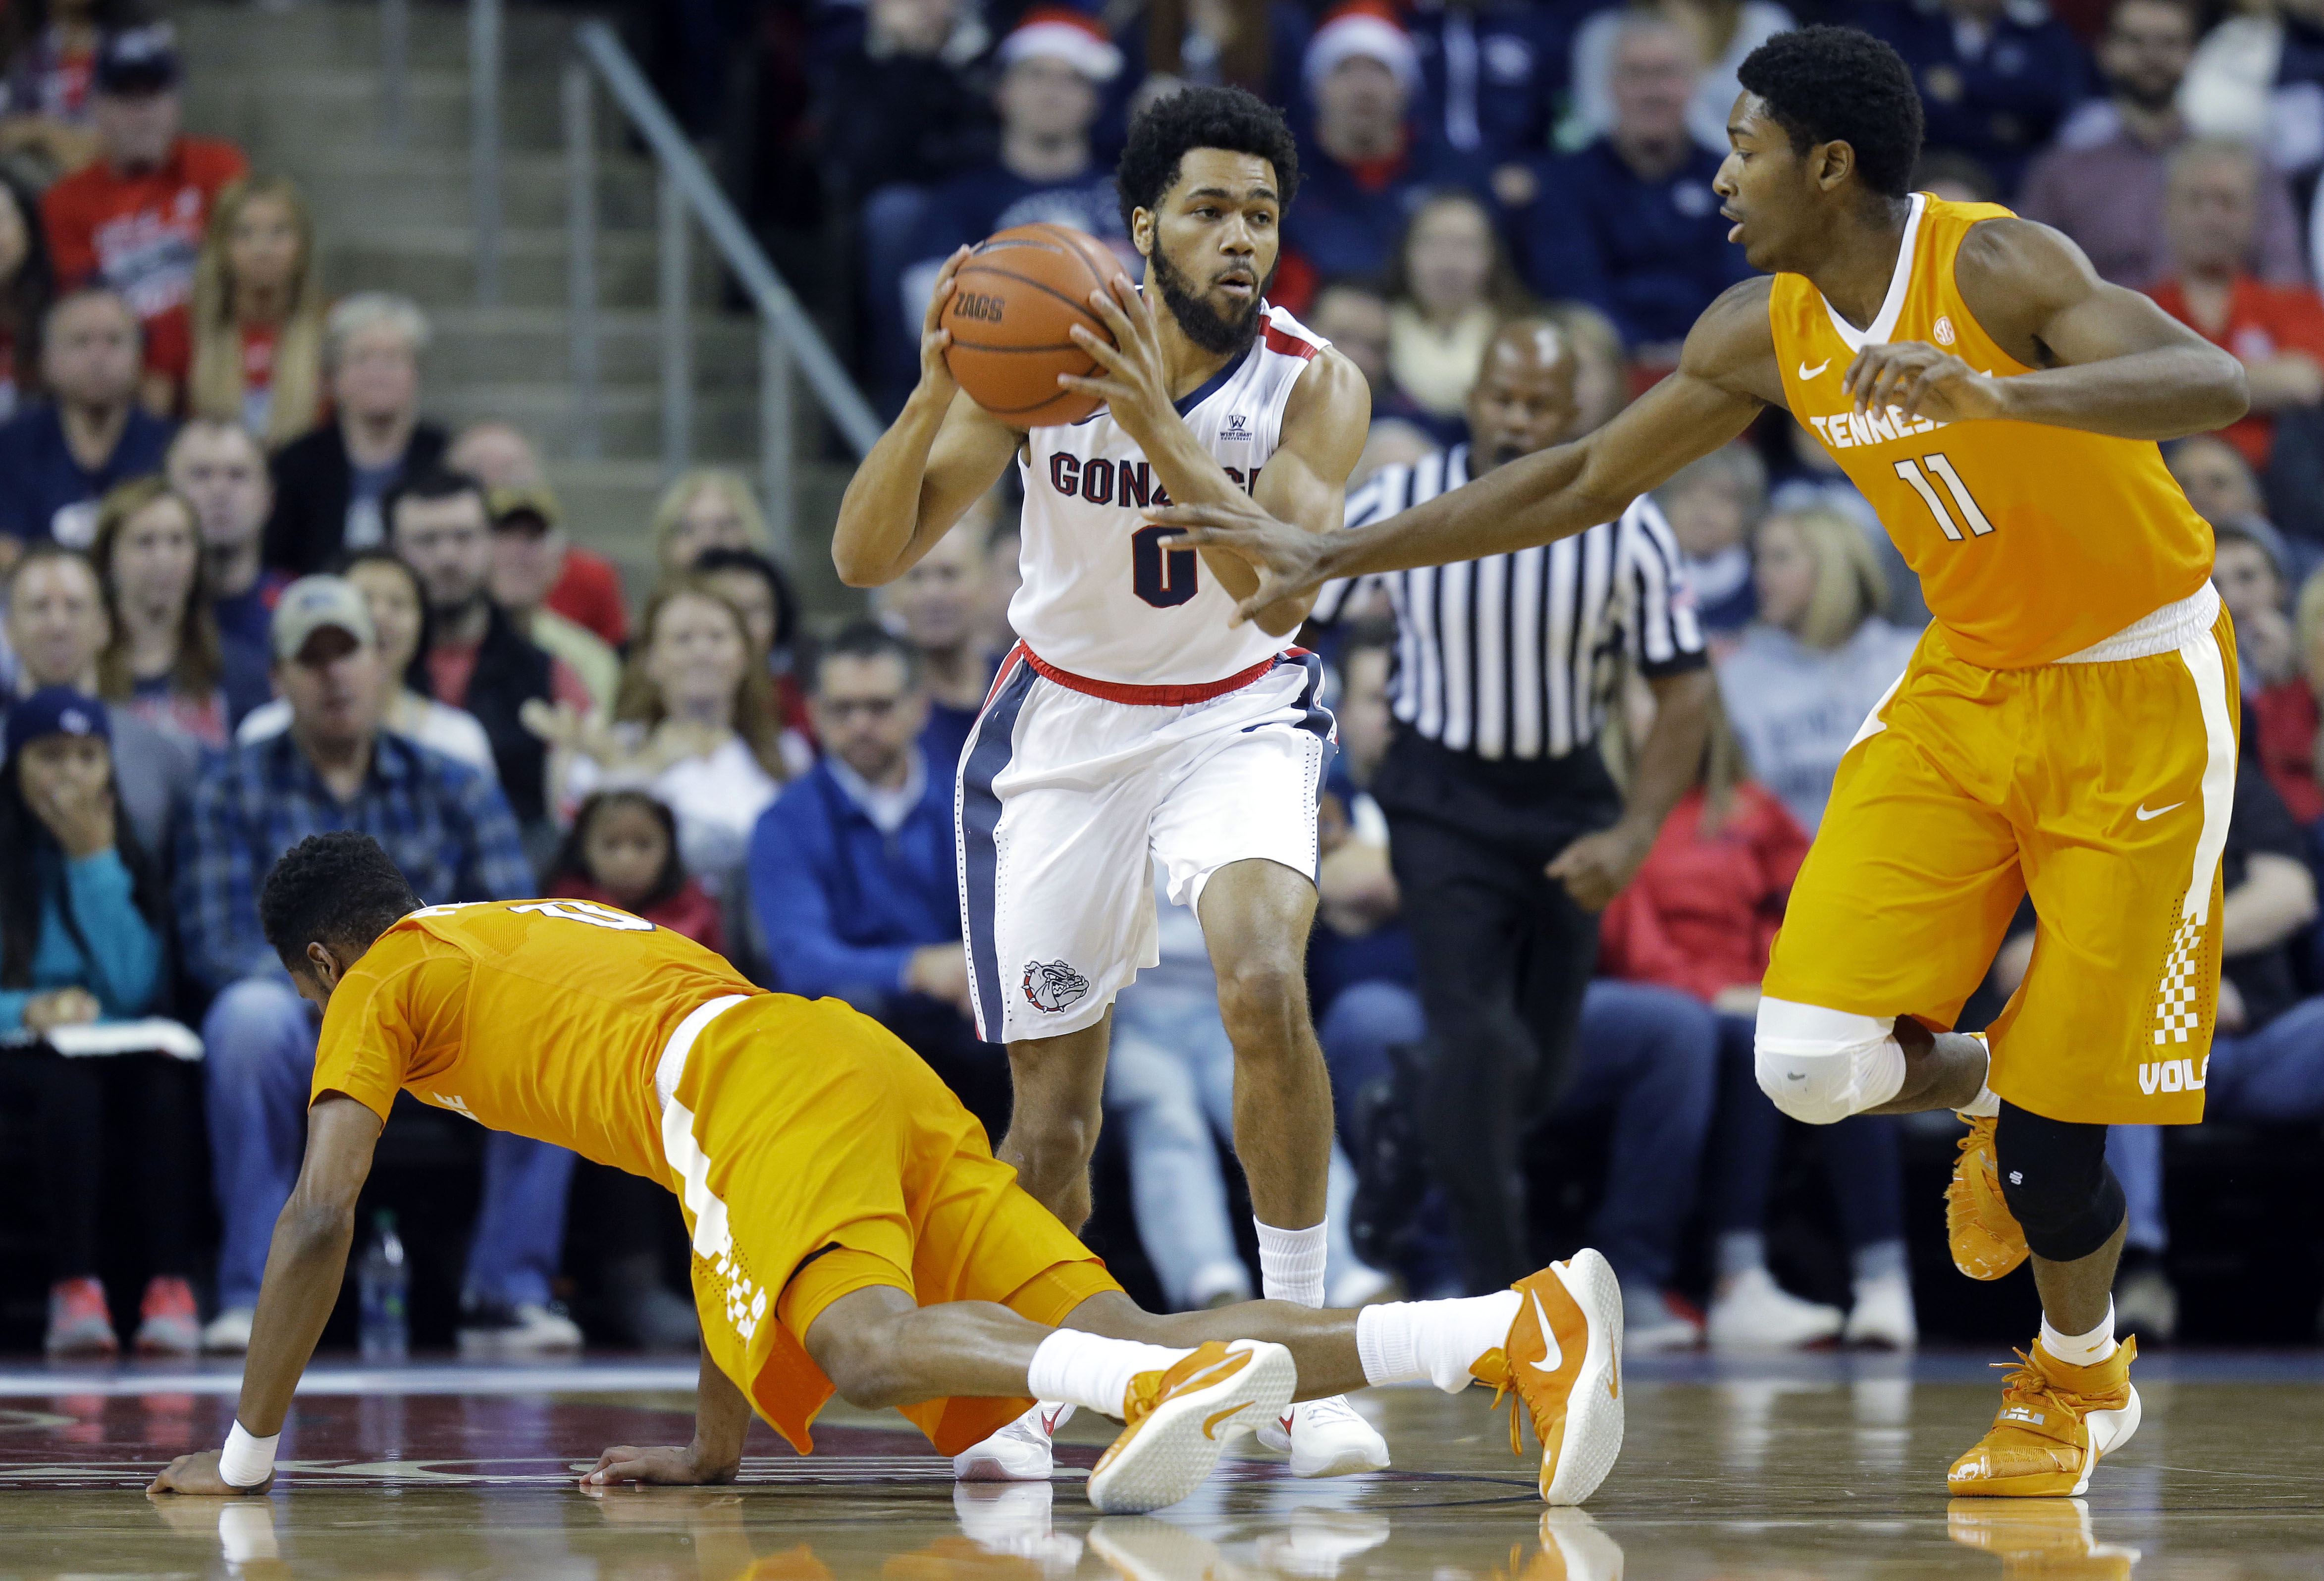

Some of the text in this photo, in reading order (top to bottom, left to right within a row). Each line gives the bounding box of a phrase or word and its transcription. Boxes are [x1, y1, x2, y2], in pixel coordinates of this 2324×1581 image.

[1809, 403, 1951, 448] TENNES
[1893, 452, 1995, 540] 11
[1132, 524, 1198, 608] 0
